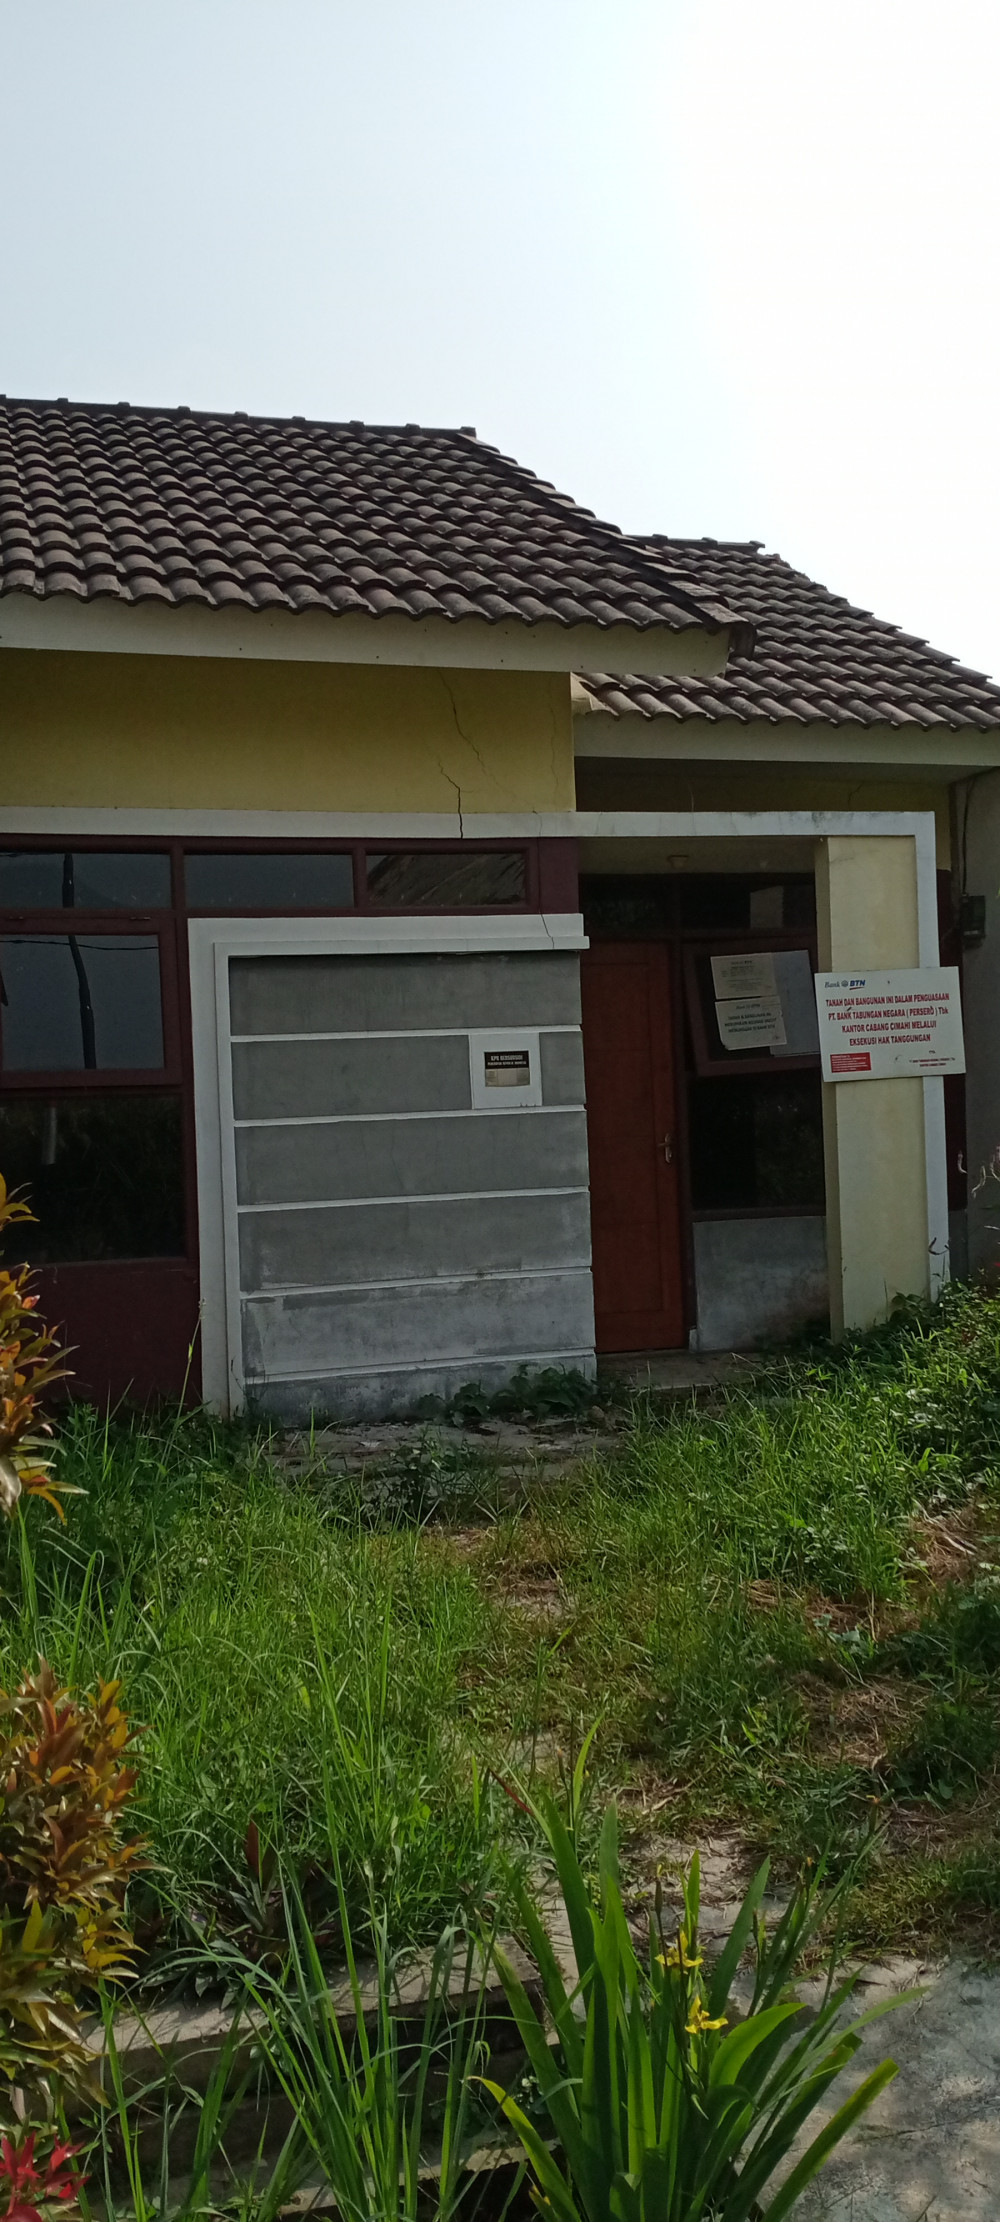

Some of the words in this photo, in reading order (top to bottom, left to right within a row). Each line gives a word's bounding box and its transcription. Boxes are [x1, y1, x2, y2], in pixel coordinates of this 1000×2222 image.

[826, 998, 843, 1007] TANAH
[844, 998, 855, 1006] DAN
[856, 996, 885, 1006] BANGUNAN
[886, 995, 894, 1003] INI
[895, 994, 913, 1003] DALAM
[914, 993, 949, 1002] PENGUASAAN
[828, 1013, 836, 1021] PT.
[837, 1011, 851, 1020] BANK
[853, 1010, 882, 1019] TABUNGAN
[883, 1009, 905, 1018] NEGARA
[910, 1007, 934, 1016] PERSERO
[938, 1006, 948, 1015] Tbk
[842, 1024, 865, 1033] KANTOR
[866, 1023, 889, 1032] CABANG
[890, 1021, 911, 1031] CIMAHI
[912, 1020, 937, 1029] MELALUI
[849, 1037, 877, 1046] EKSEKUSI
[878, 1036, 890, 1044] HAK
[891, 1034, 931, 1044] TANGGUNGAN
